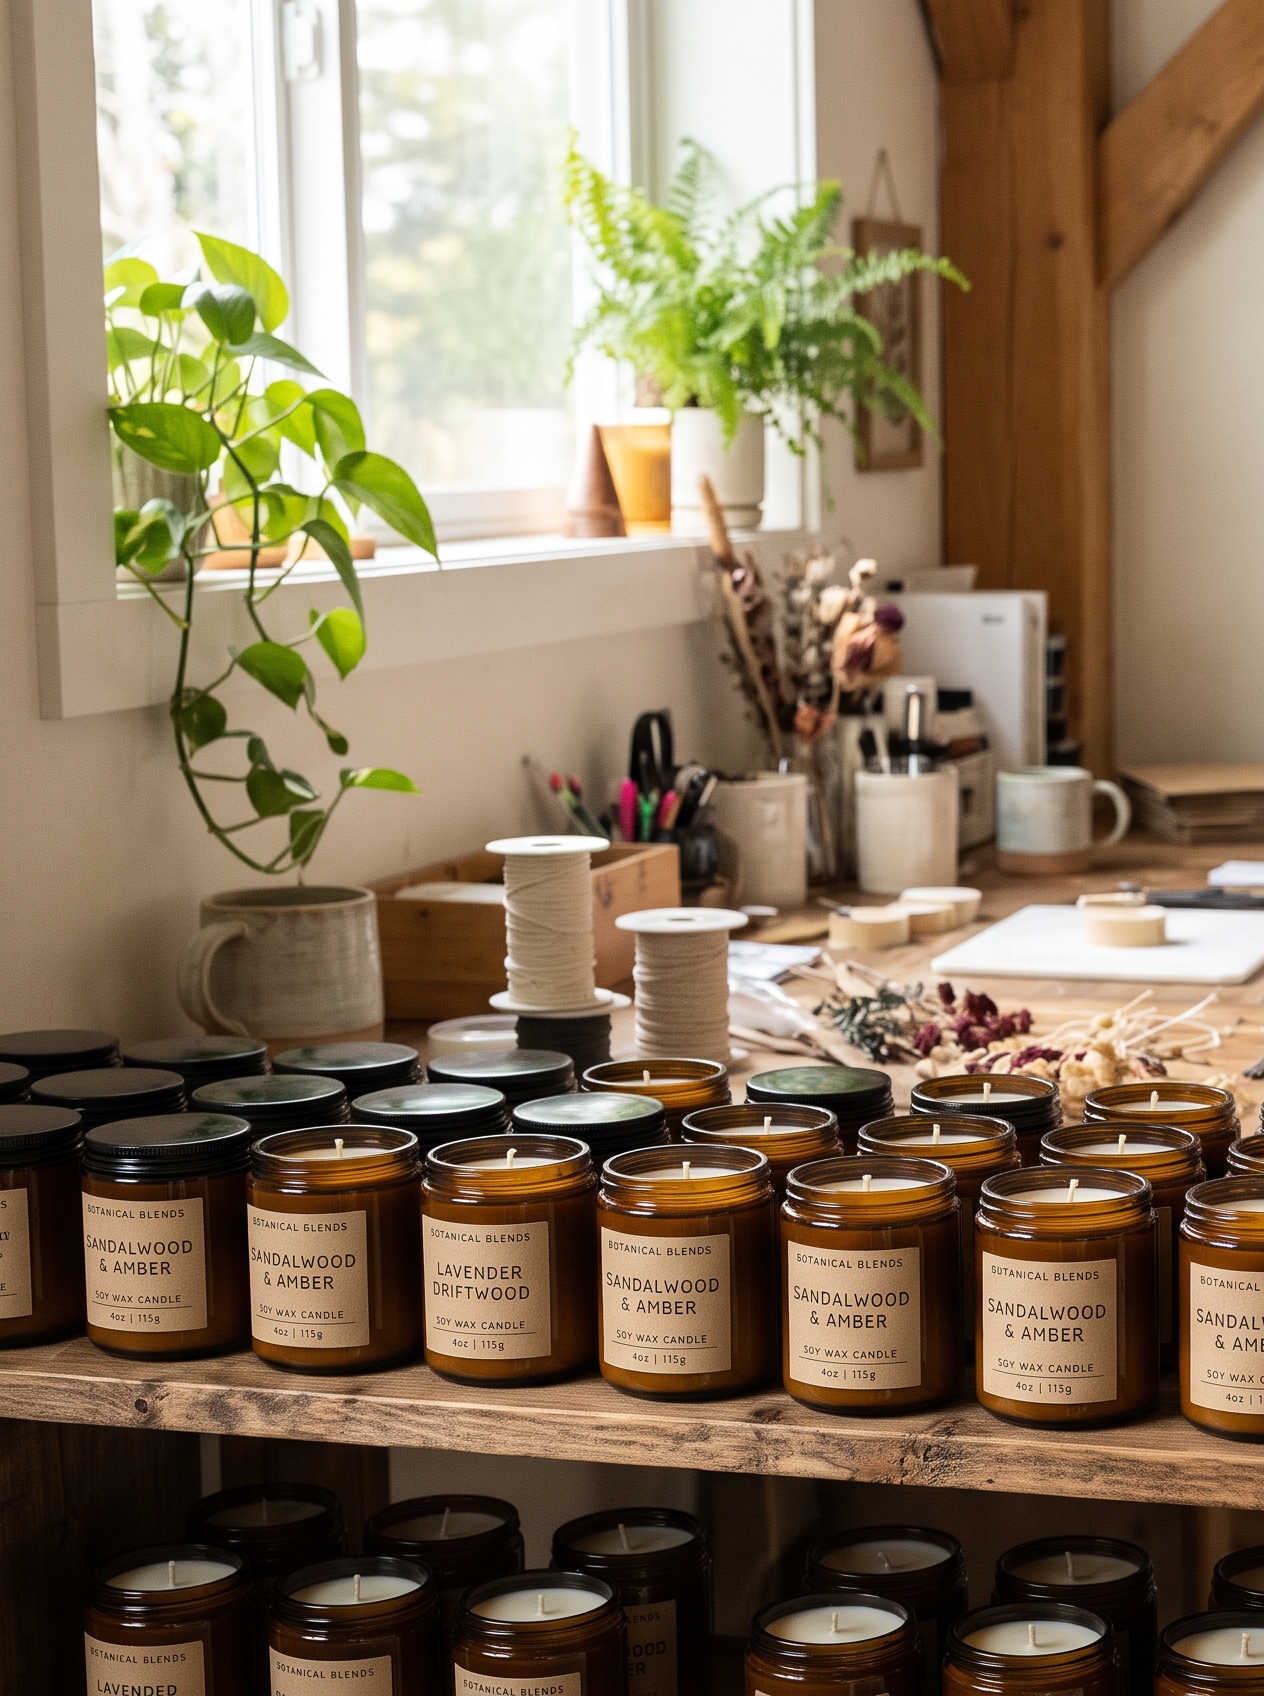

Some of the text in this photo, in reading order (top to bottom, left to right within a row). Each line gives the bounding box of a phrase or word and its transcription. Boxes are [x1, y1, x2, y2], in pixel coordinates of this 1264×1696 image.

[140, 1209, 184, 1219] BLENDS
[87, 1235, 192, 1255] SANDALWOOD
[486, 1233, 530, 1243] BLENDS
[609, 1240, 711, 1256] BOTANICAL BLENDS
[252, 1247, 355, 1268] SANDALWOOD
[858, 1259, 902, 1269] BLENDS
[100, 1258, 171, 1275] & AMBER
[438, 1262, 522, 1280] LAVENDER
[264, 1272, 333, 1289] & AMBER
[607, 1272, 719, 1293] SANDALWOOD
[1054, 1271, 1099, 1281] BLENDS
[433, 1281, 529, 1300] DRIFTWOOD
[1201, 1276, 1260, 1291] BOTANICAL
[112, 1294, 133, 1303] WAX
[138, 1295, 181, 1303] CANDLE
[794, 1286, 909, 1307] SANDALWOOD
[622, 1297, 696, 1314] & AMBER
[988, 1298, 1105, 1320] SANDALWOOD
[110, 1313, 125, 1321] 4oz
[138, 1314, 160, 1324] 115g
[276, 1309, 296, 1318] WAX
[301, 1311, 343, 1319] CANDLE
[810, 1311, 886, 1328] & AMBER
[437, 1316, 524, 1330] SOY WAX CANDLE
[274, 1327, 288, 1336] 4oz
[301, 1330, 322, 1340] 115g
[617, 1330, 706, 1344] SOY WAX CANDLE
[1005, 1324, 1083, 1342] & AMBER
[453, 1339, 468, 1347] 4oz
[482, 1341, 504, 1351] 115g
[1215, 1335, 1225, 1349] &
[804, 1345, 897, 1359] SOY WAX CANDLE
[633, 1353, 649, 1362] 4oz
[663, 1355, 685, 1366] 115g
[822, 1368, 838, 1378] 4oz
[1019, 1363, 1042, 1372] WAX
[1048, 1364, 1093, 1373] CANDLE
[1207, 1369, 1225, 1379] SOY
[1230, 1374, 1254, 1383] WAX
[1016, 1382, 1033, 1391] 4oz
[1048, 1384, 1071, 1395] 115g
[1226, 1393, 1243, 1403] 4oz
[331, 1668, 374, 1679] BLENDS
[521, 1686, 563, 1696] BLENDS
